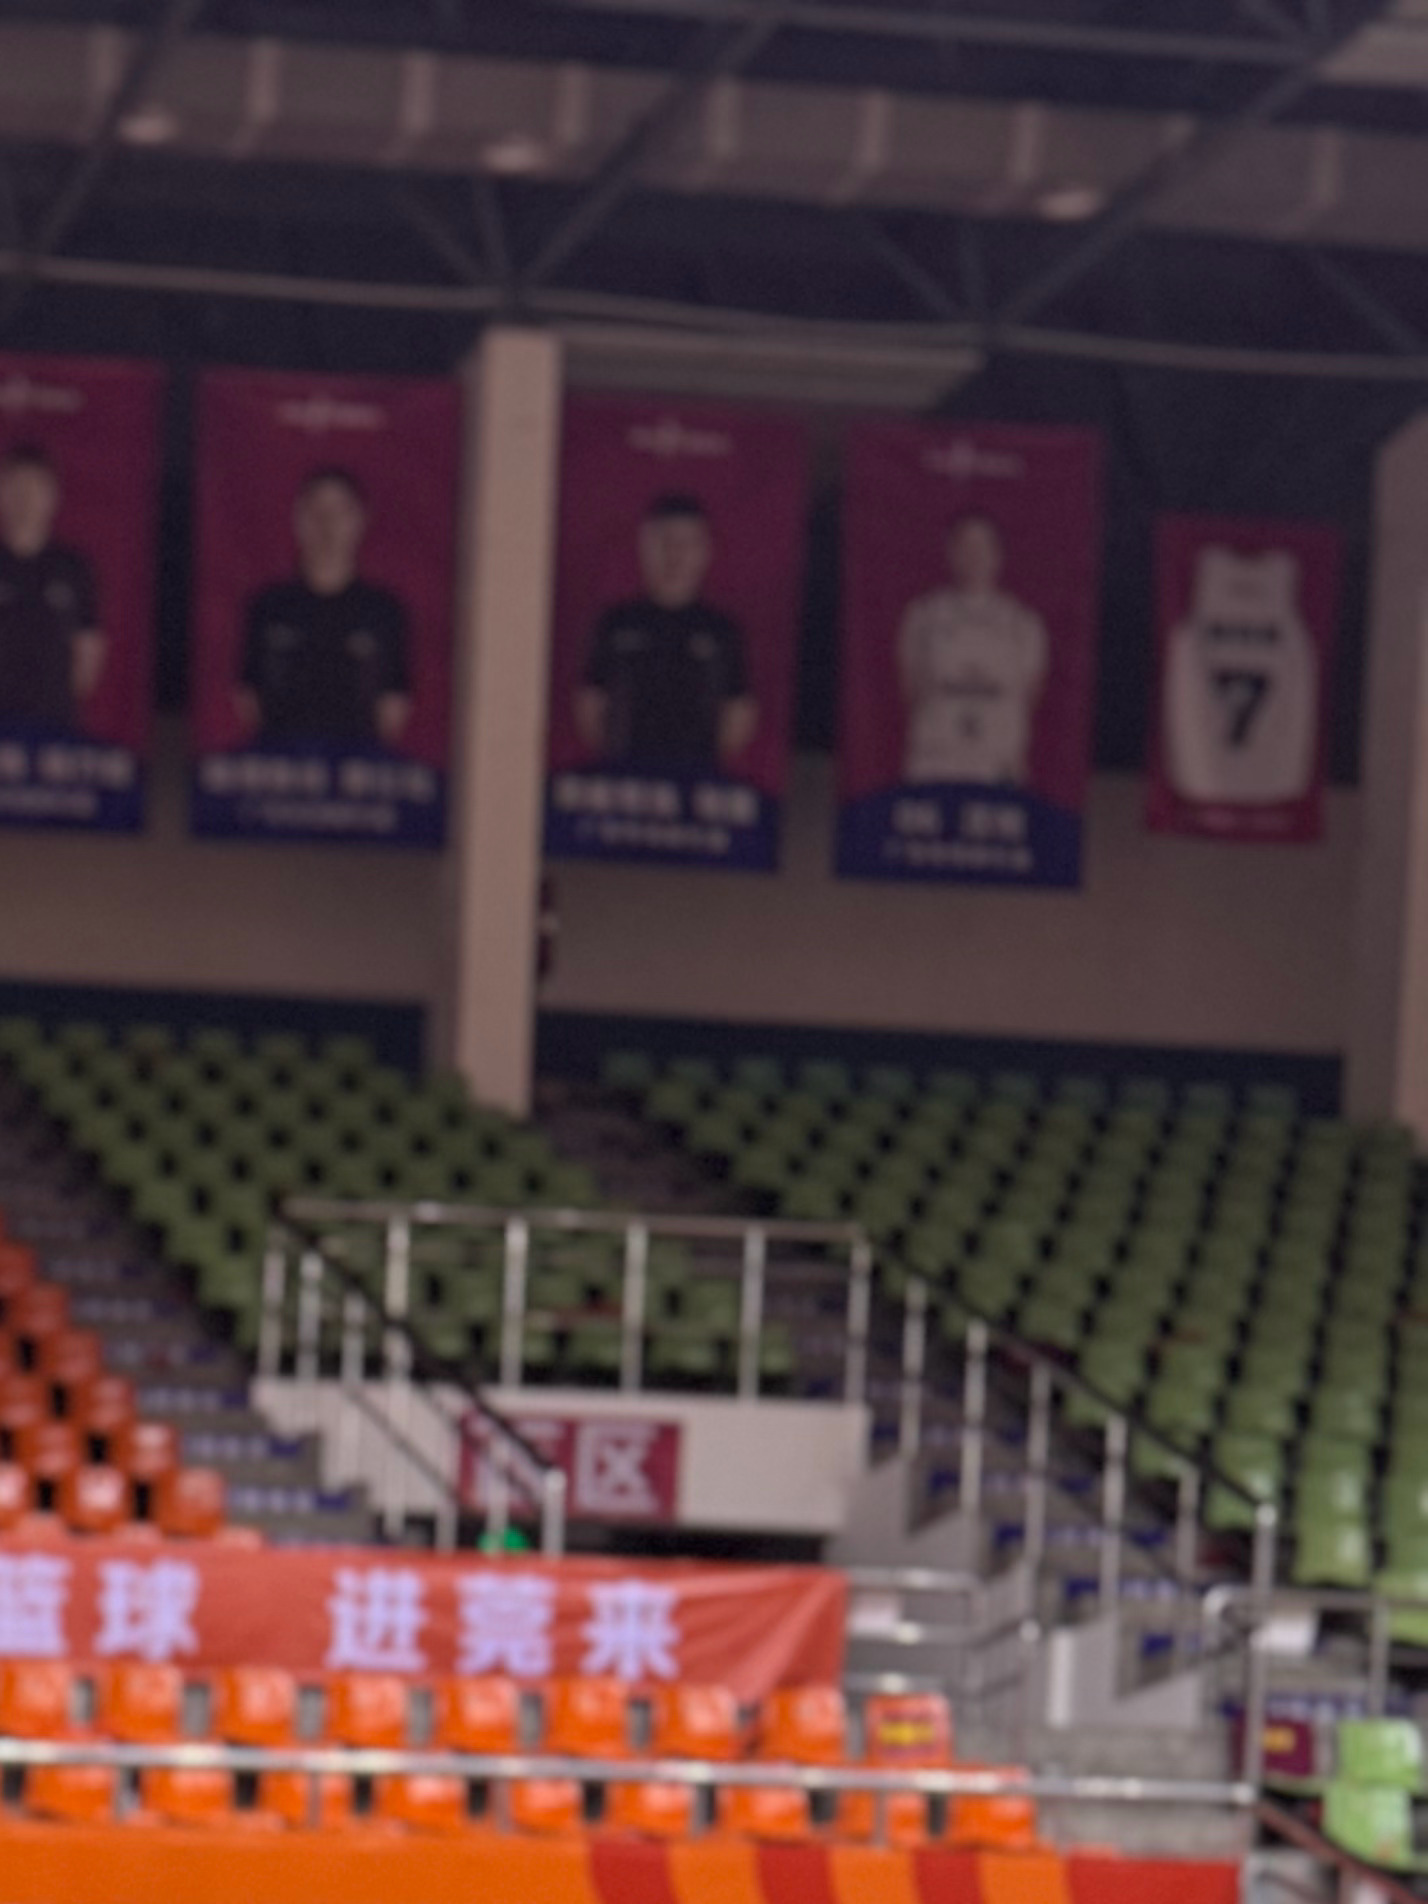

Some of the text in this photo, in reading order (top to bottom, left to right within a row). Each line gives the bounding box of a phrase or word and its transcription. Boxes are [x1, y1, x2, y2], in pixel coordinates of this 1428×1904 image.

[1212, 669, 1273, 748] 7
[325, 1567, 681, 1679] 进莞来
